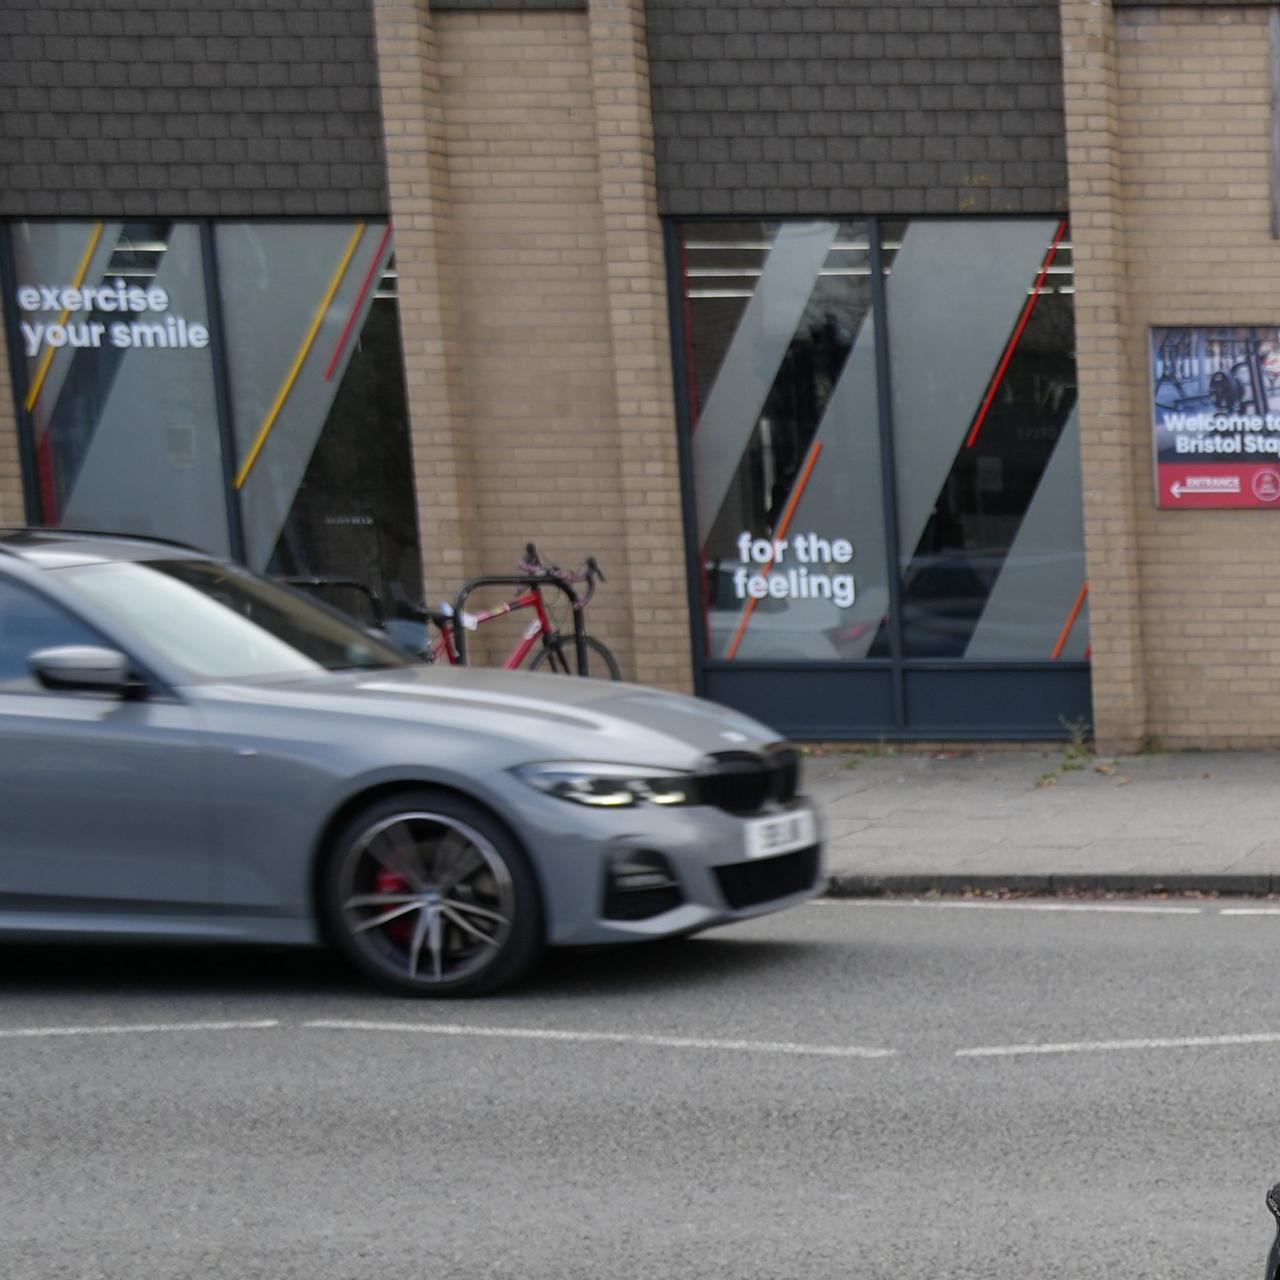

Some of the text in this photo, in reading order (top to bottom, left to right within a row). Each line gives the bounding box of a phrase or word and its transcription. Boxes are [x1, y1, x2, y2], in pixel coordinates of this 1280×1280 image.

[18, 277, 169, 312] exercise
[21, 315, 209, 357] your smile
[1164, 413, 1263, 432] Welcome
[1175, 434, 1241, 454] Bristol
[737, 531, 853, 563] for the
[733, 567, 855, 608] feeling
